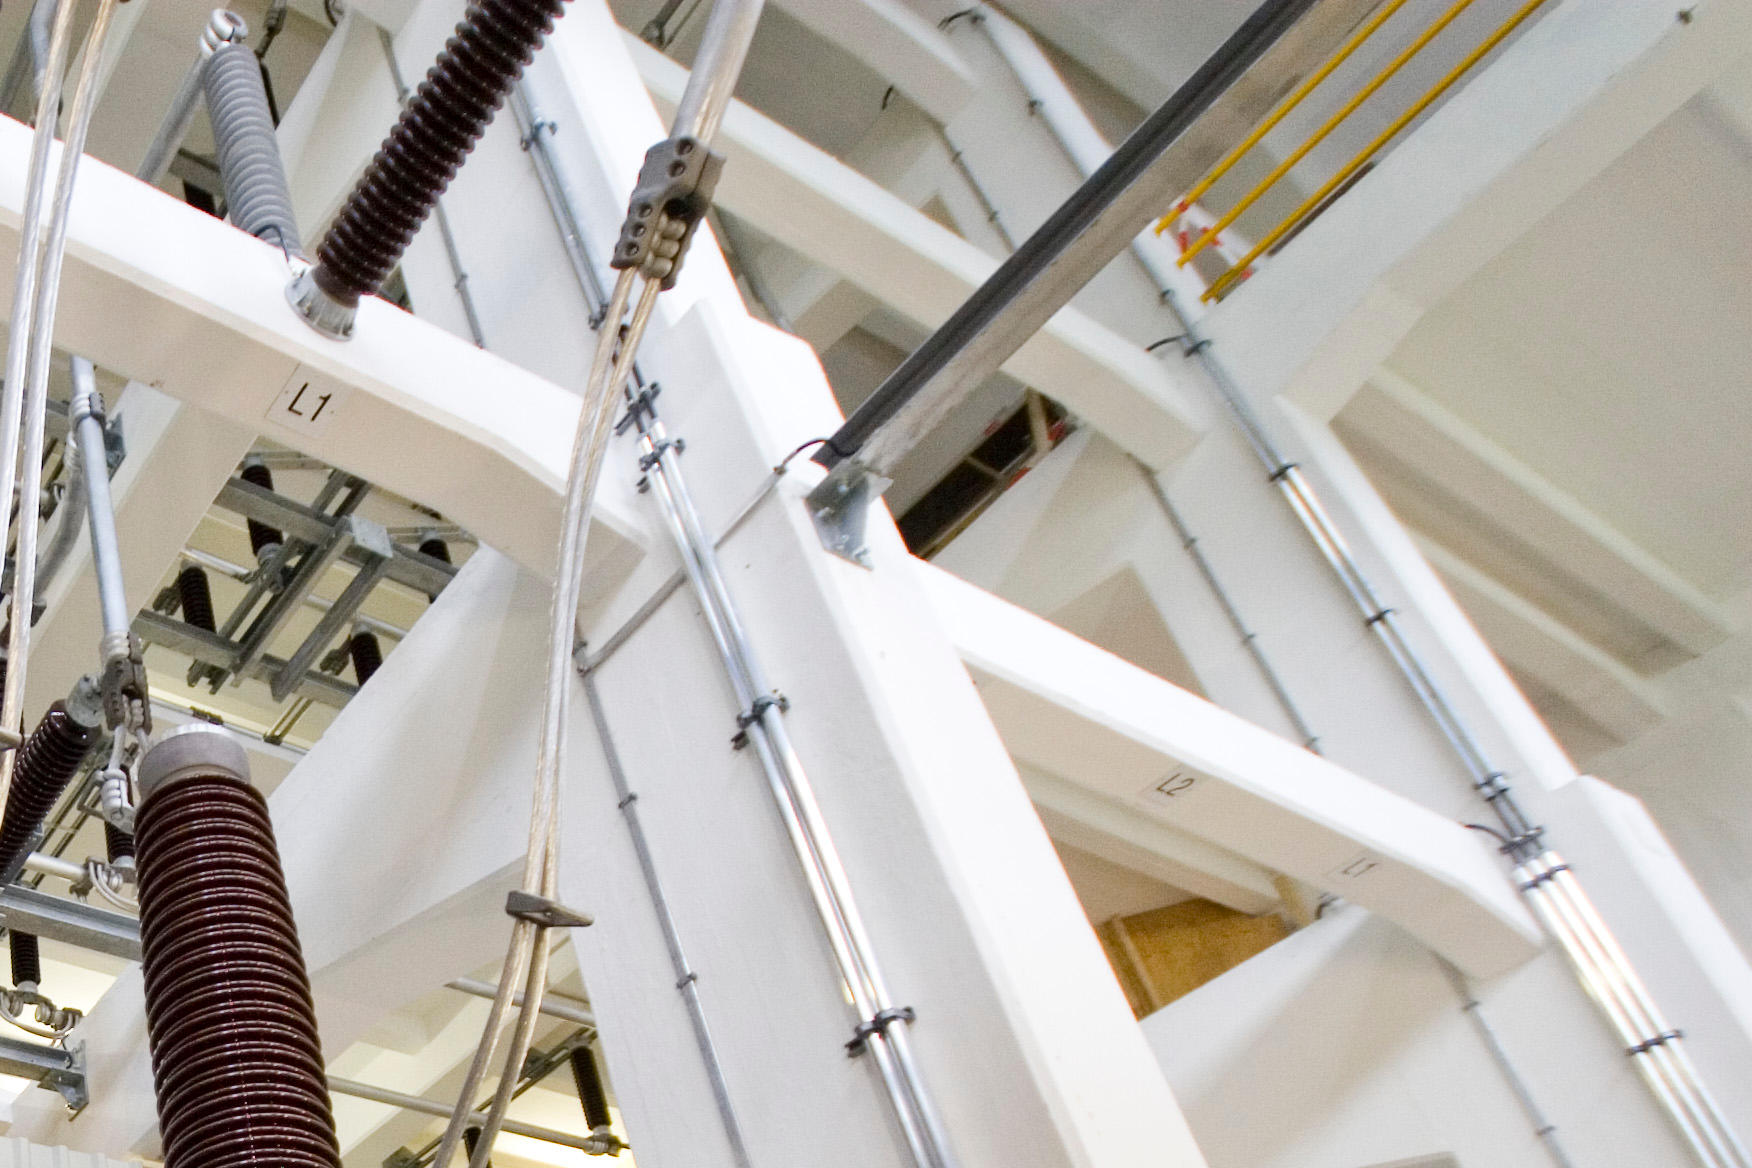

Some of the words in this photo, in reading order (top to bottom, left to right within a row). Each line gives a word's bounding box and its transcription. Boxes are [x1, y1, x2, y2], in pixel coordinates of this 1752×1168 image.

[288, 382, 332, 422] L1
[1156, 772, 1195, 797] L2
[1341, 857, 1380, 878] L1
